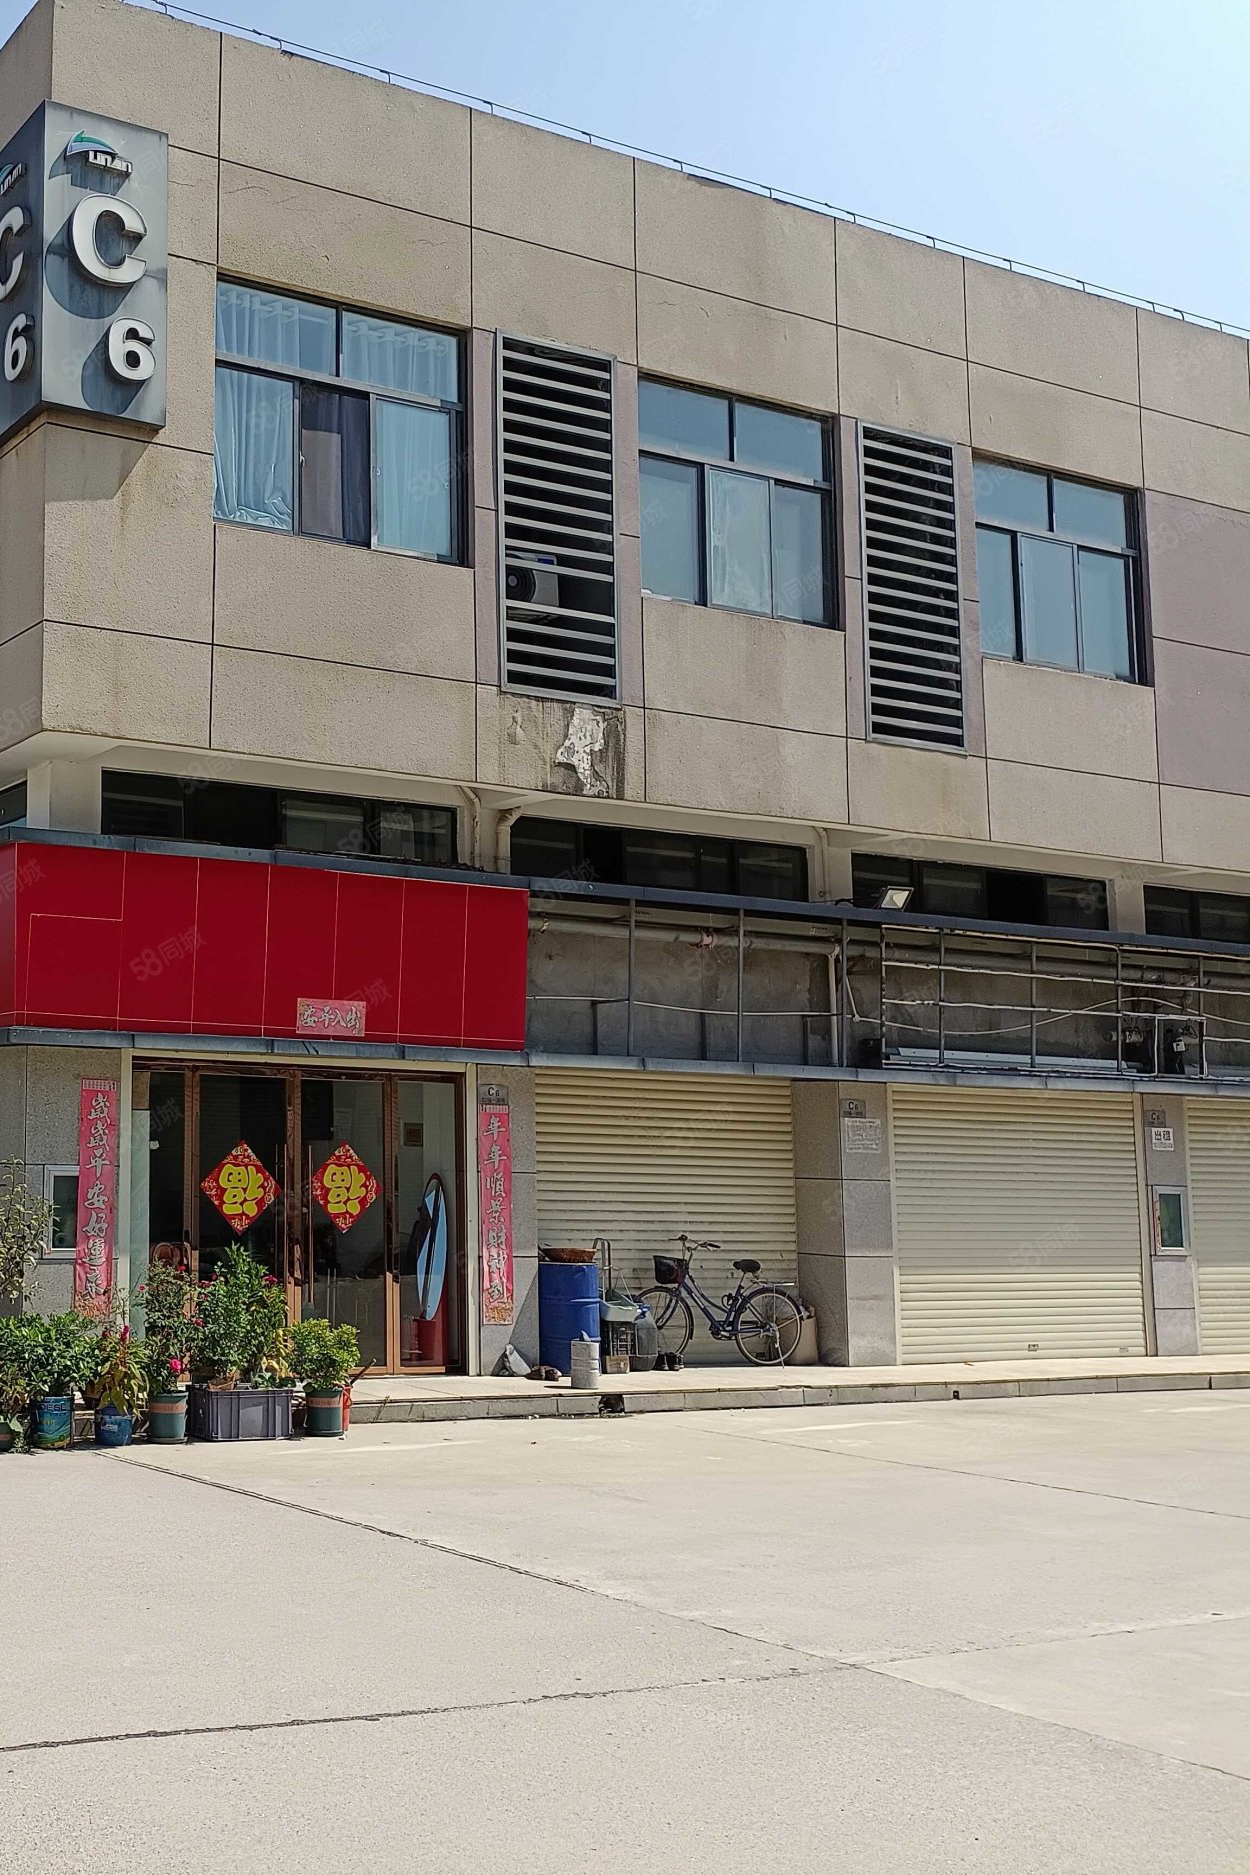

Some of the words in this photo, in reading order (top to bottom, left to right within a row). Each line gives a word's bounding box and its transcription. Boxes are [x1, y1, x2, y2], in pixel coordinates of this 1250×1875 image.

[71, 193, 148, 285] C
[4, 312, 35, 382] 6
[108, 316, 156, 381] 6
